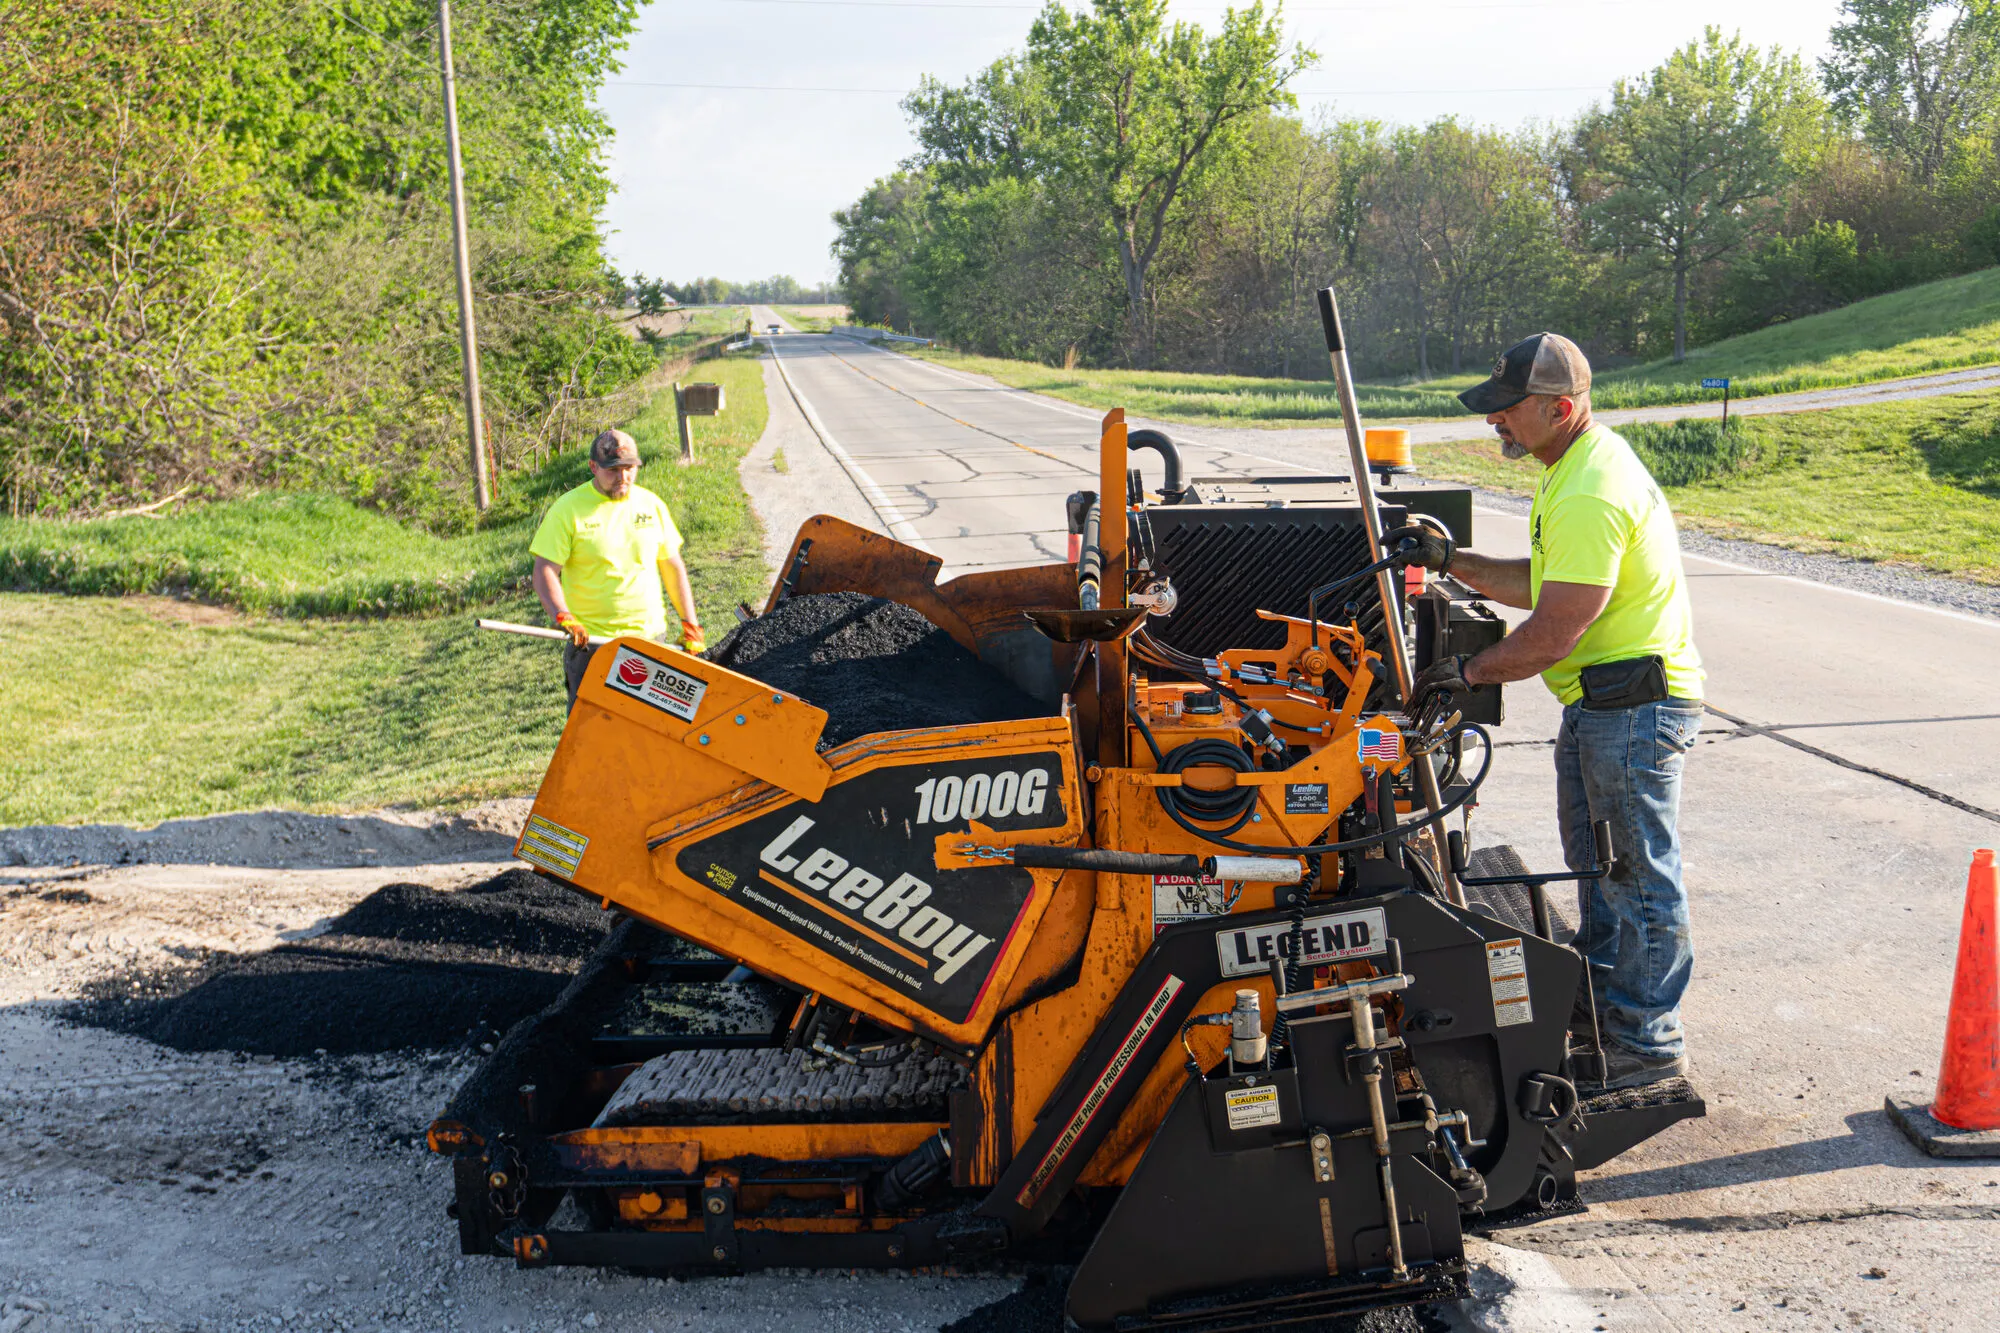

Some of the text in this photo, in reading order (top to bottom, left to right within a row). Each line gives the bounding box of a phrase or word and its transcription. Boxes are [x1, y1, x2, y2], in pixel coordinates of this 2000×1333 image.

[652, 680, 693, 702] EQUIPMENT
[654, 669, 698, 697] ROSE
[915, 768, 1048, 825] 1000G
[547, 824, 570, 837] CAUTION
[534, 849, 561, 865] ATTENTION
[710, 863, 737, 881] CAUTION
[715, 872, 734, 886] PINCH
[713, 877, 732, 890] POINT
[760, 814, 993, 985] LeeBoy
[742, 885, 778, 910] Equipment
[777, 905, 809, 927] Designed
[806, 920, 823, 935] With
[822, 930, 834, 941] the
[833, 936, 857, 955] Paving
[857, 948, 897, 976] Professional
[903, 974, 923, 990] Mind.
[1306, 946, 1372, 961] Screed System
[1056, 1133, 1074, 1158] WITH
[1070, 1114, 1085, 1136] THE
[1083, 1085, 1106, 1118] PAVING
[1102, 1026, 1148, 1089] PROFESSIONAL
[1144, 1012, 1155, 1029] IN
[1235, 1094, 1270, 1105] CAUTION
